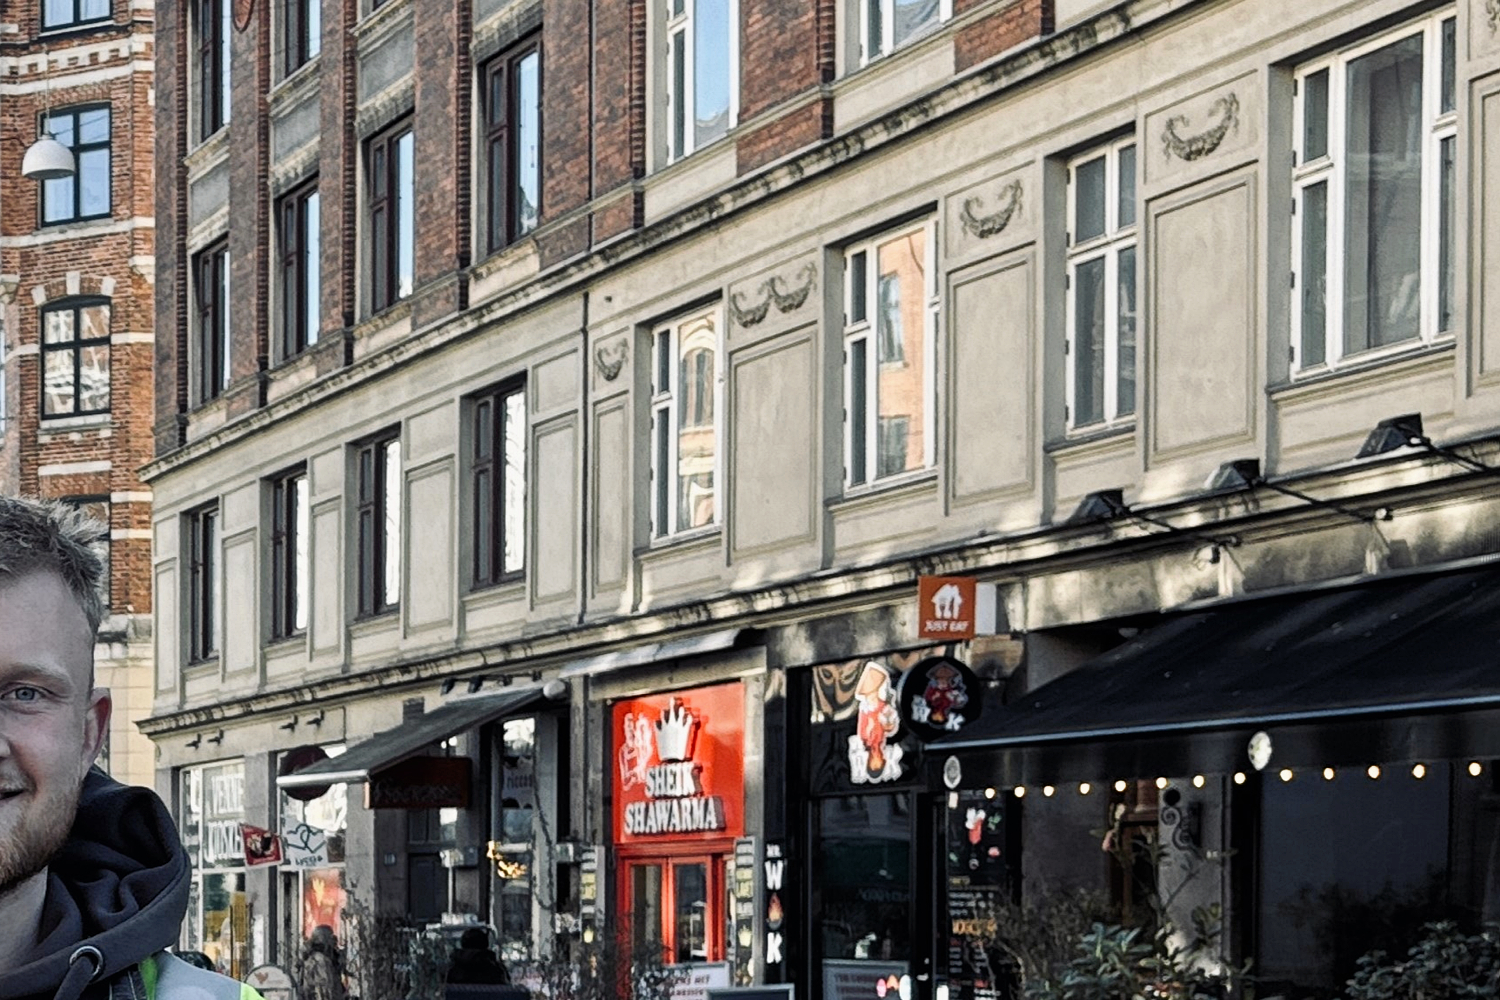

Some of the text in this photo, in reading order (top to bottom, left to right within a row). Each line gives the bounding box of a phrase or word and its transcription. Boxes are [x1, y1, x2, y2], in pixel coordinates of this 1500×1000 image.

[923, 619, 970, 633] JUST EAT
[645, 762, 696, 798] SHEIK
[624, 796, 718, 834] SHAWARMA
